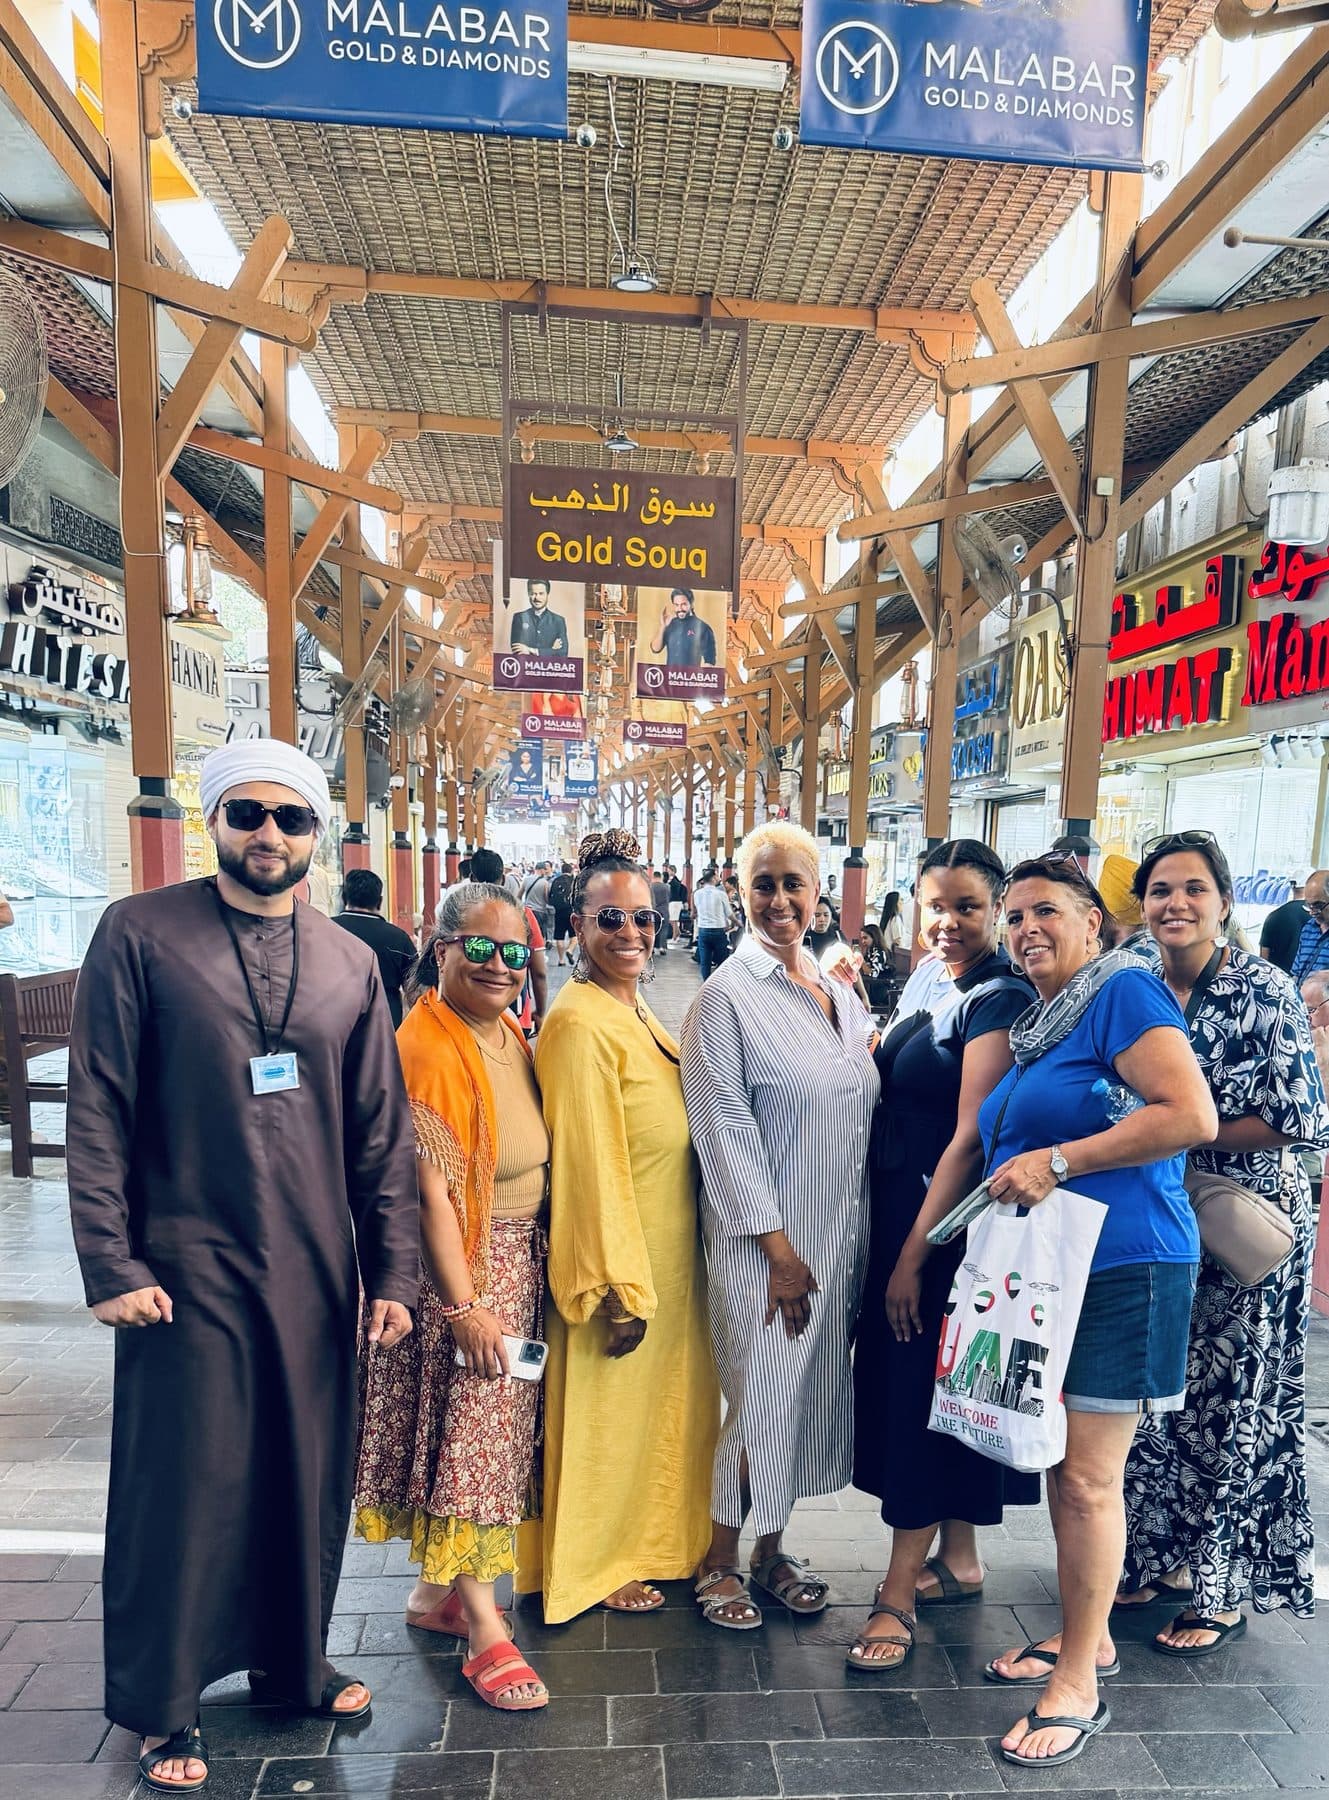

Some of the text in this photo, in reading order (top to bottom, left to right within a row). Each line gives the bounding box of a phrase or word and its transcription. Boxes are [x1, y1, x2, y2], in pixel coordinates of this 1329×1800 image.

[326, 0, 552, 51] MALABAR
[328, 39, 551, 79] GOLD & DIAMONDS
[925, 42, 1136, 101] MALABAR
[924, 86, 1135, 128] GOLD & DIAMONDS
[529, 482, 716, 526] سوق الذهب
[536, 532, 707, 578] Gold Souq
[525, 661, 576, 673] MALABAR
[668, 671, 718, 682] MALABAR
[1102, 647, 1219, 744] HIMAT
[543, 719, 582, 729] MALABAR
[645, 726, 683, 735] MALABAR
[935, 1415, 958, 1432] THE
[939, 1399, 999, 1430] WELCOME
